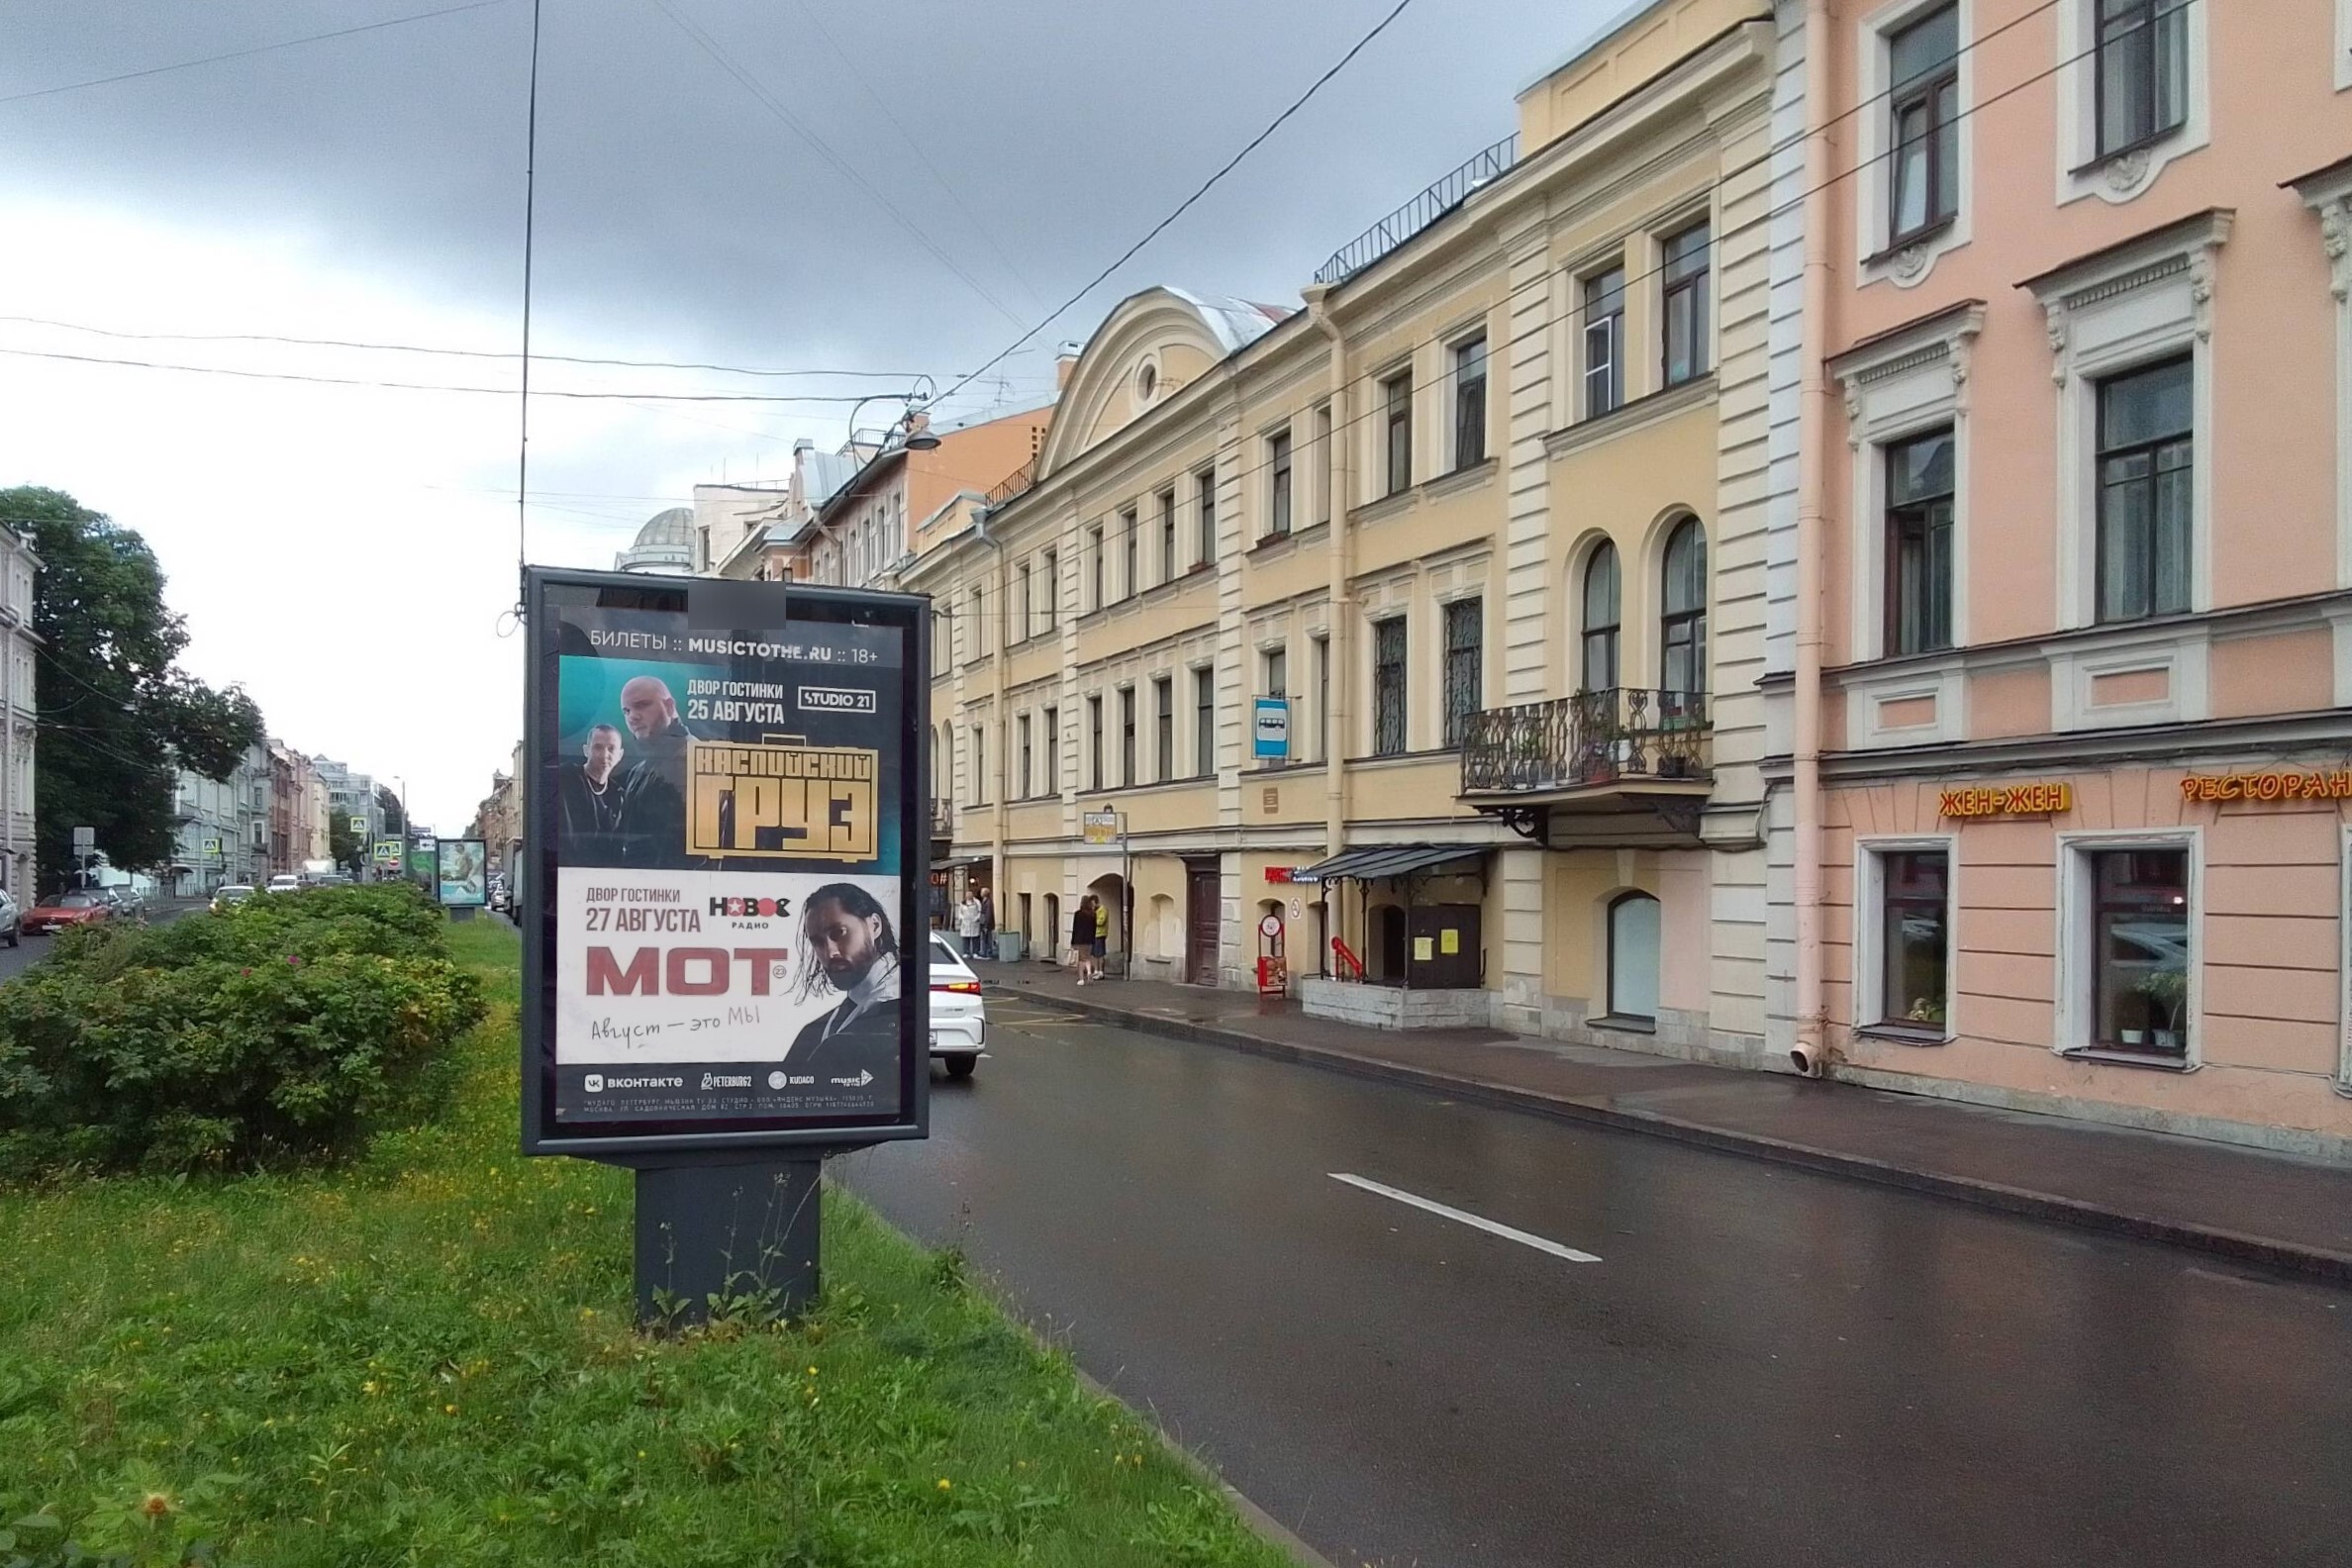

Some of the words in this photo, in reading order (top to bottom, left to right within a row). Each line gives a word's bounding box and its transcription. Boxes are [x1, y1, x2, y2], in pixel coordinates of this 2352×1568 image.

[590, 630, 667, 650] БИЛЕТЫ
[688, 637, 832, 660] MUSICTOTHE.RU
[850, 648, 878, 664] 18+
[686, 679, 721, 695] ДВОР
[723, 681, 784, 699] ГОСТИНКИ
[804, 692, 854, 707] STUDIO
[856, 695, 870, 708] 21
[687, 699, 709, 720] 25
[712, 700, 785, 725] АВГУСТА
[695, 747, 871, 780] КАСПИЙСКИЙ
[1939, 783, 2064, 817] ЖЕН-ЖЕН
[2180, 769, 2352, 802] РЕСТОРАН
[695, 775, 871, 853] ГРУЗ
[586, 887, 619, 903] ДВОР
[621, 888, 681, 903] ГОСТИНКИ
[586, 908, 612, 931] 27
[615, 908, 702, 932] АВГУСТА
[586, 946, 788, 997] МОТ
[591, 1017, 660, 1048] Август
